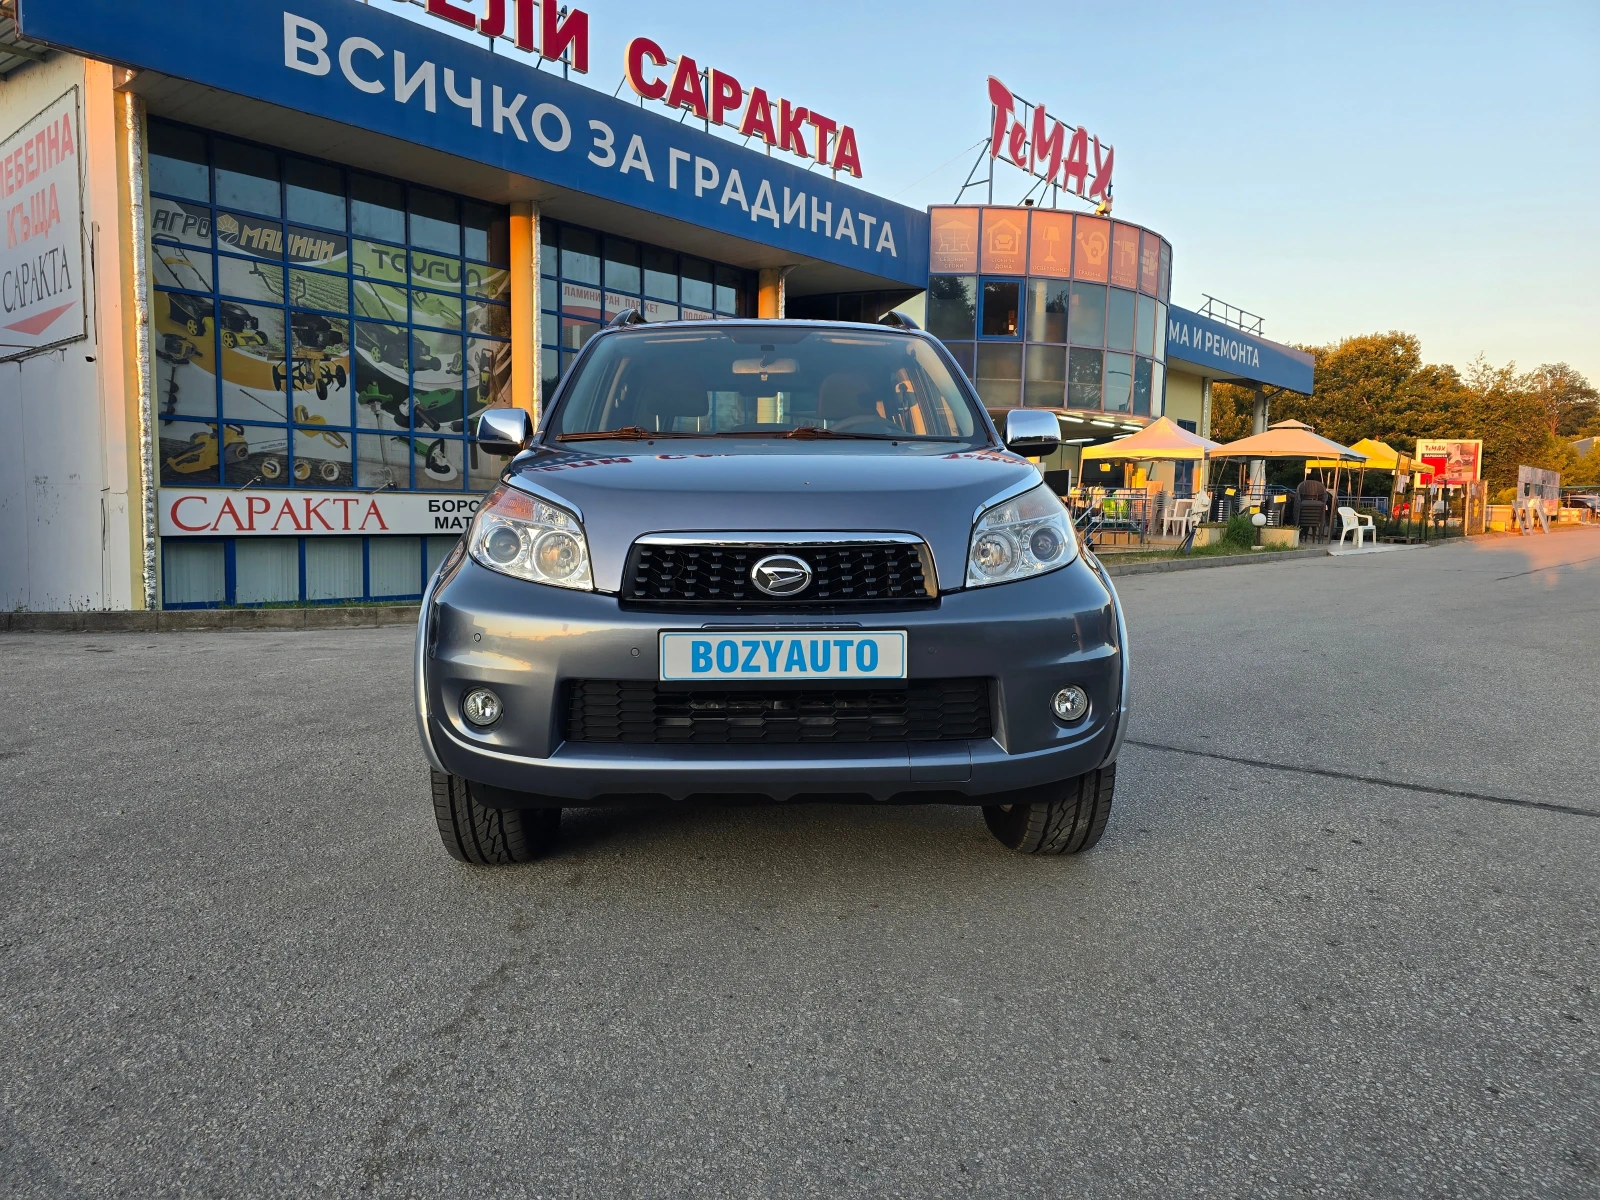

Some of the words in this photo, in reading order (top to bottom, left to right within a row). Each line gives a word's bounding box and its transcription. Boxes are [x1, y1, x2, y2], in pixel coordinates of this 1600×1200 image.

[424, 0, 588, 74] ЛИ
[624, 37, 862, 178] САРАКТА
[283, 11, 572, 153] ВСИЧКО
[588, 120, 654, 183] ЗА
[668, 147, 898, 258] ГРАДИНАТА
[6, 182, 61, 250] КЪЩА
[152, 209, 211, 239] АГРО
[240, 224, 336, 262] МАШИНИ
[2, 244, 73, 314] САРАКТА
[564, 286, 620, 307] ЛАМИНИРАН
[625, 298, 659, 314] ПАРКЕТ
[1169, 319, 1189, 347] МА
[1193, 326, 1202, 350] И
[1205, 331, 1260, 368] РЕМОНТА
[170, 496, 389, 532] САРАКТА
[434, 516, 473, 529] МАТ
[691, 639, 879, 674] BOZYAUTO
